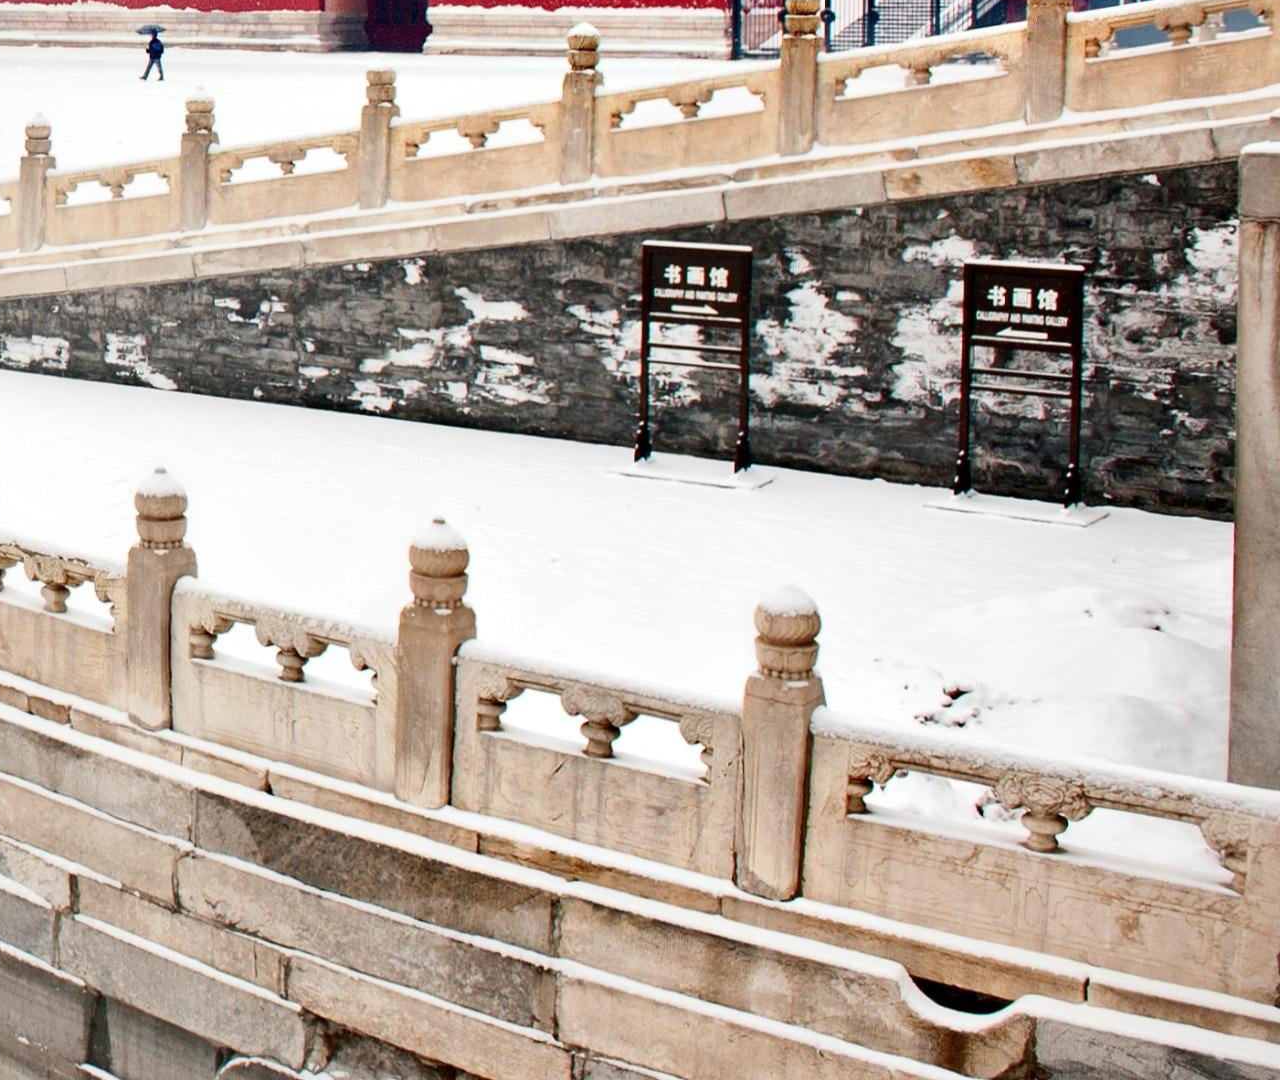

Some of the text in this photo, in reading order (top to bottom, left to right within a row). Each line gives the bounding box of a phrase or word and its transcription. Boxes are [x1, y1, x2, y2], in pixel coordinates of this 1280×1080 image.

[663, 264, 729, 288] 书画馆
[987, 285, 1059, 311] 书画馆
